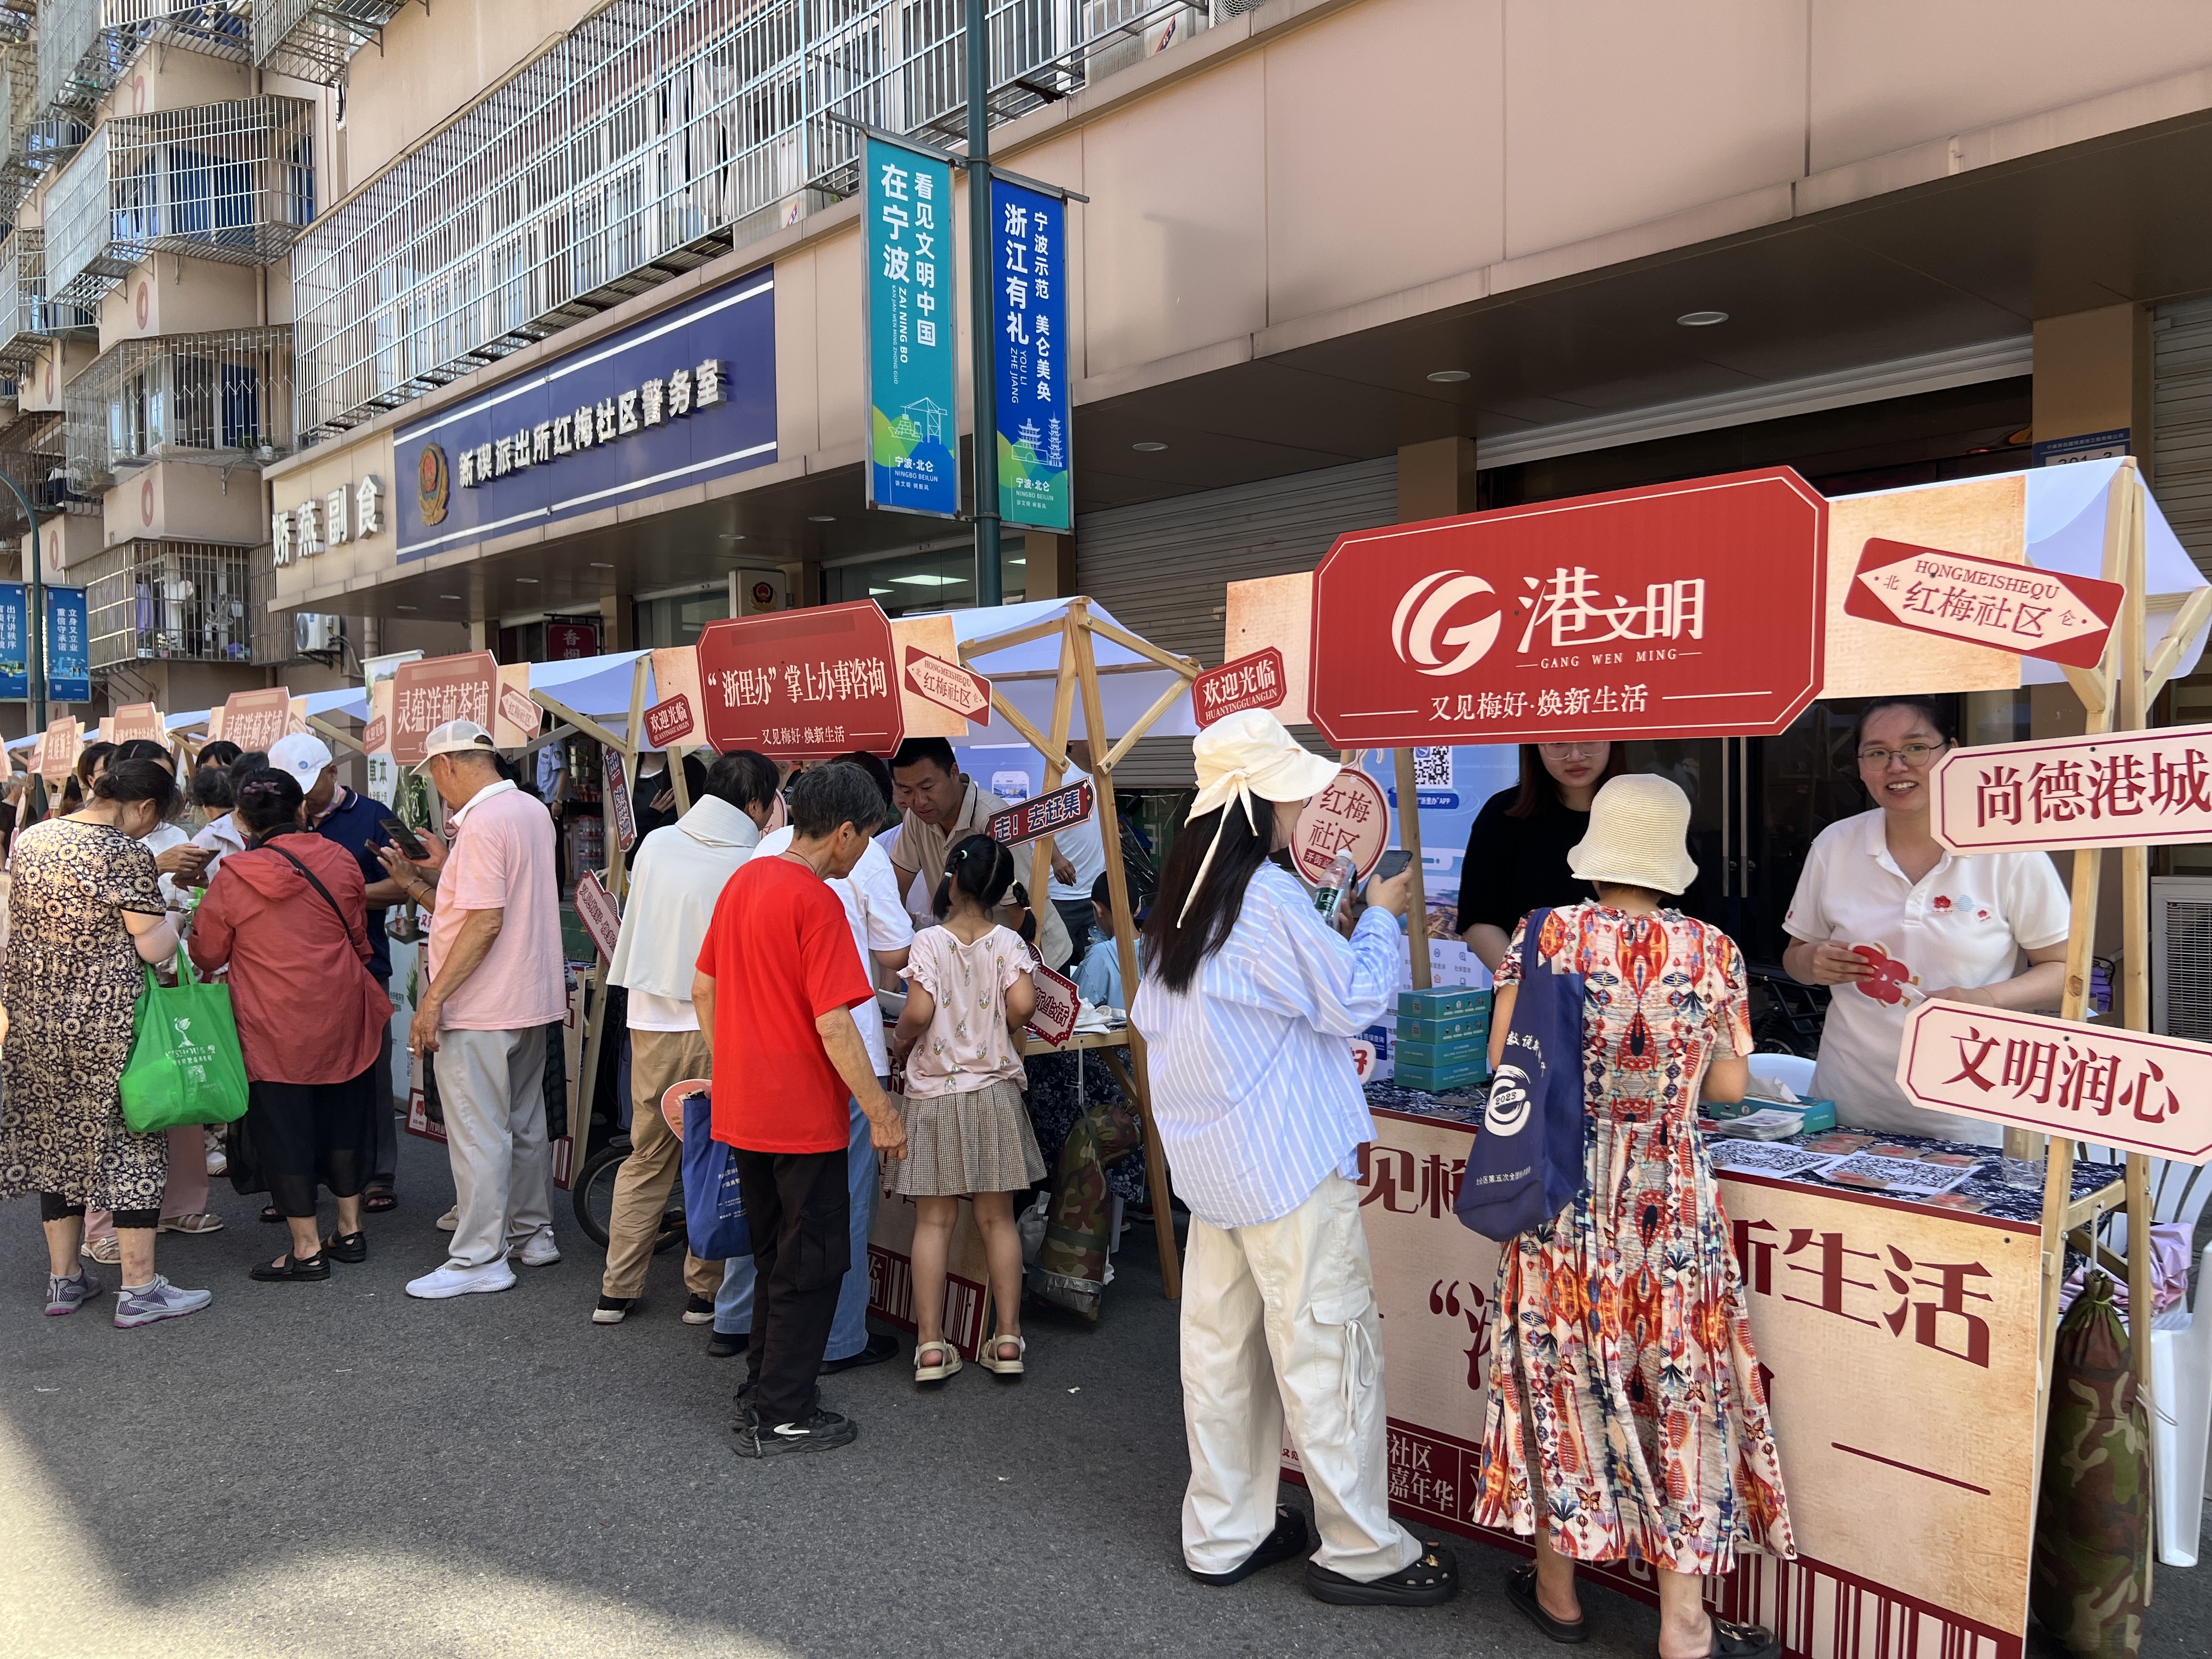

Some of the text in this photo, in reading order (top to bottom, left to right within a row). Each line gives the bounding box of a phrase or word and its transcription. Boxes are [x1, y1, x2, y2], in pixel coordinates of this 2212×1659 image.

[881, 163, 910, 284] 在宁波
[914, 172, 935, 347] 看见文明中国
[1005, 203, 1029, 345] 浙江有礼
[1034, 212, 1049, 300] 宁波示范
[899, 287, 908, 363] ZAI NING BO
[1009, 370, 1019, 404] JIANG
[1020, 376, 1027, 385] LI
[458, 358, 727, 488] 新碶派出所红梅社区警务室
[895, 455, 934, 472] 宁波·北仑
[895, 470, 938, 482] NINGBO BEILUN
[1015, 477, 1050, 492] 宁波·北仑
[1016, 490, 1036, 498] NINGBO
[272, 475, 381, 567] 娇燕副食
[1914, 560, 2061, 600] HONGMEISHEQU
[1516, 566, 1705, 654] 港文明
[1902, 580, 2052, 638] 红梅社区
[924, 659, 972, 688] HONGMEISHEQU
[1541, 648, 1678, 669] GANG WEN MING
[923, 671, 972, 708] 红梅社区
[1202, 657, 1277, 709] 欢迎光临
[1428, 682, 1649, 723] 又见梅好·焕新生活
[650, 701, 688, 732] 欢迎光临
[1204, 687, 1278, 722] HUANYINGGUANGLIN
[761, 725, 845, 745] 又见梅好·焕新生活
[1319, 784, 1372, 823] 红梅
[1976, 748, 2212, 828] 尚德港城
[1308, 820, 1360, 855] 社区
[1942, 1026, 2180, 1124] 文明润心
[1495, 1092, 1516, 1105] 2023
[1386, 1434, 1432, 1474] 社区
